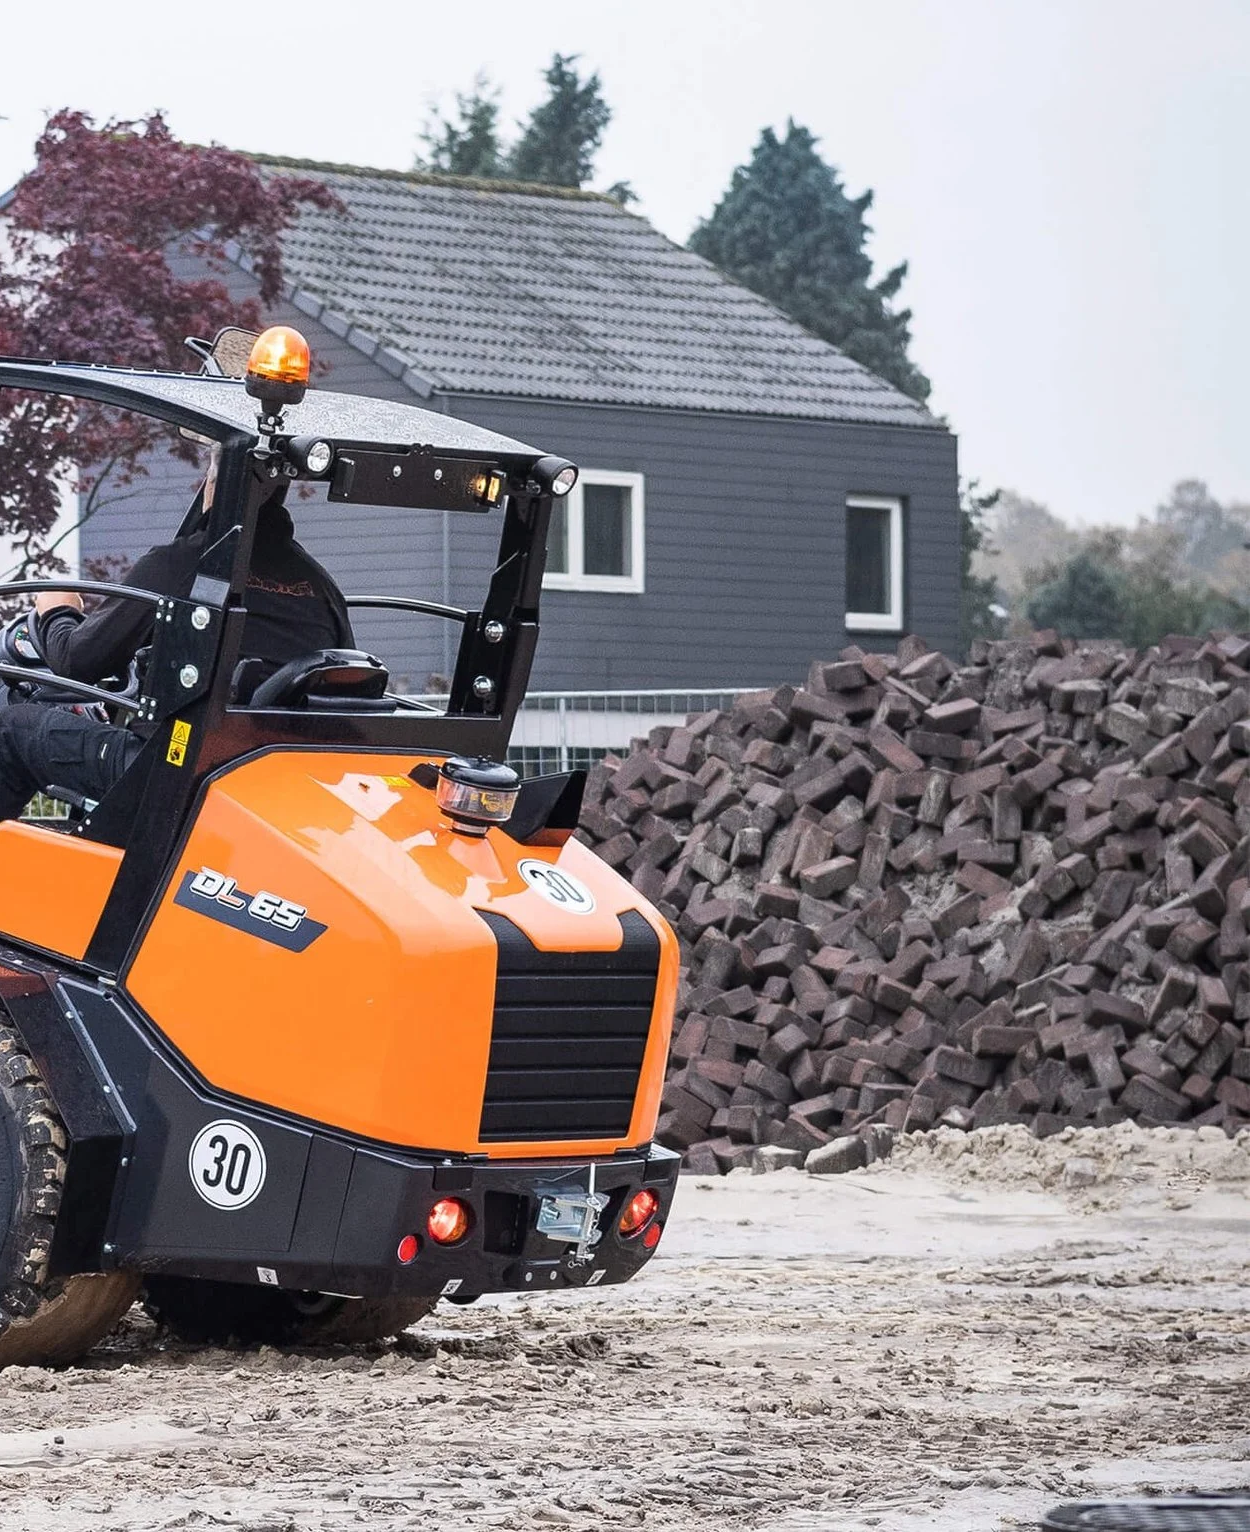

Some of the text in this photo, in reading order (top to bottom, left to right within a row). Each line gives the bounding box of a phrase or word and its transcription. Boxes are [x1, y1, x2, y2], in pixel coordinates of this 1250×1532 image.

[190, 866, 307, 932] DL 65
[530, 869, 585, 903] 30
[203, 1134, 252, 1196] 30
